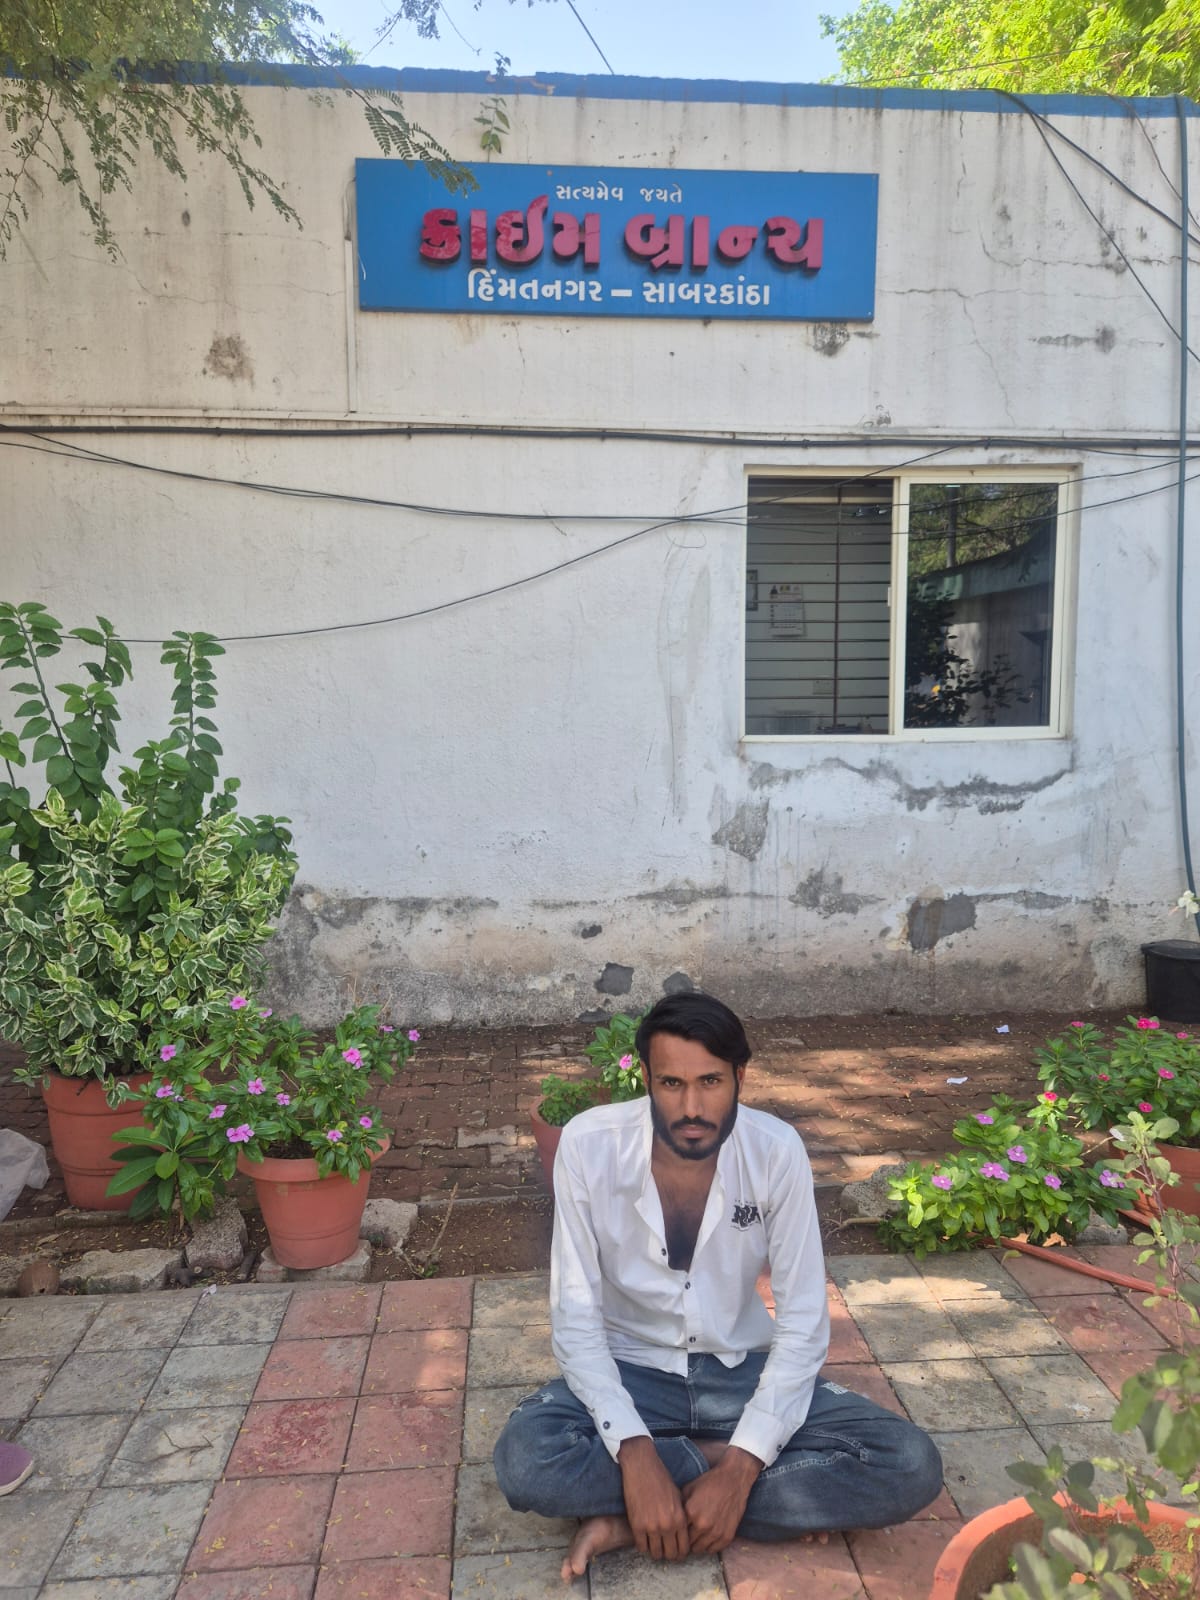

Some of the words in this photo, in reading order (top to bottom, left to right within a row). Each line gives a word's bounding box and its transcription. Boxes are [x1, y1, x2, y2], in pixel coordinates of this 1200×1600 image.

[556, 180, 624, 201] સત્યમેવ
[640, 183, 683, 203] જયતે
[624, 213, 825, 269] બ્રાન્ચ
[468, 268, 602, 301] હિંમતનગર
[643, 275, 770, 305] સાબરકાંઠા
